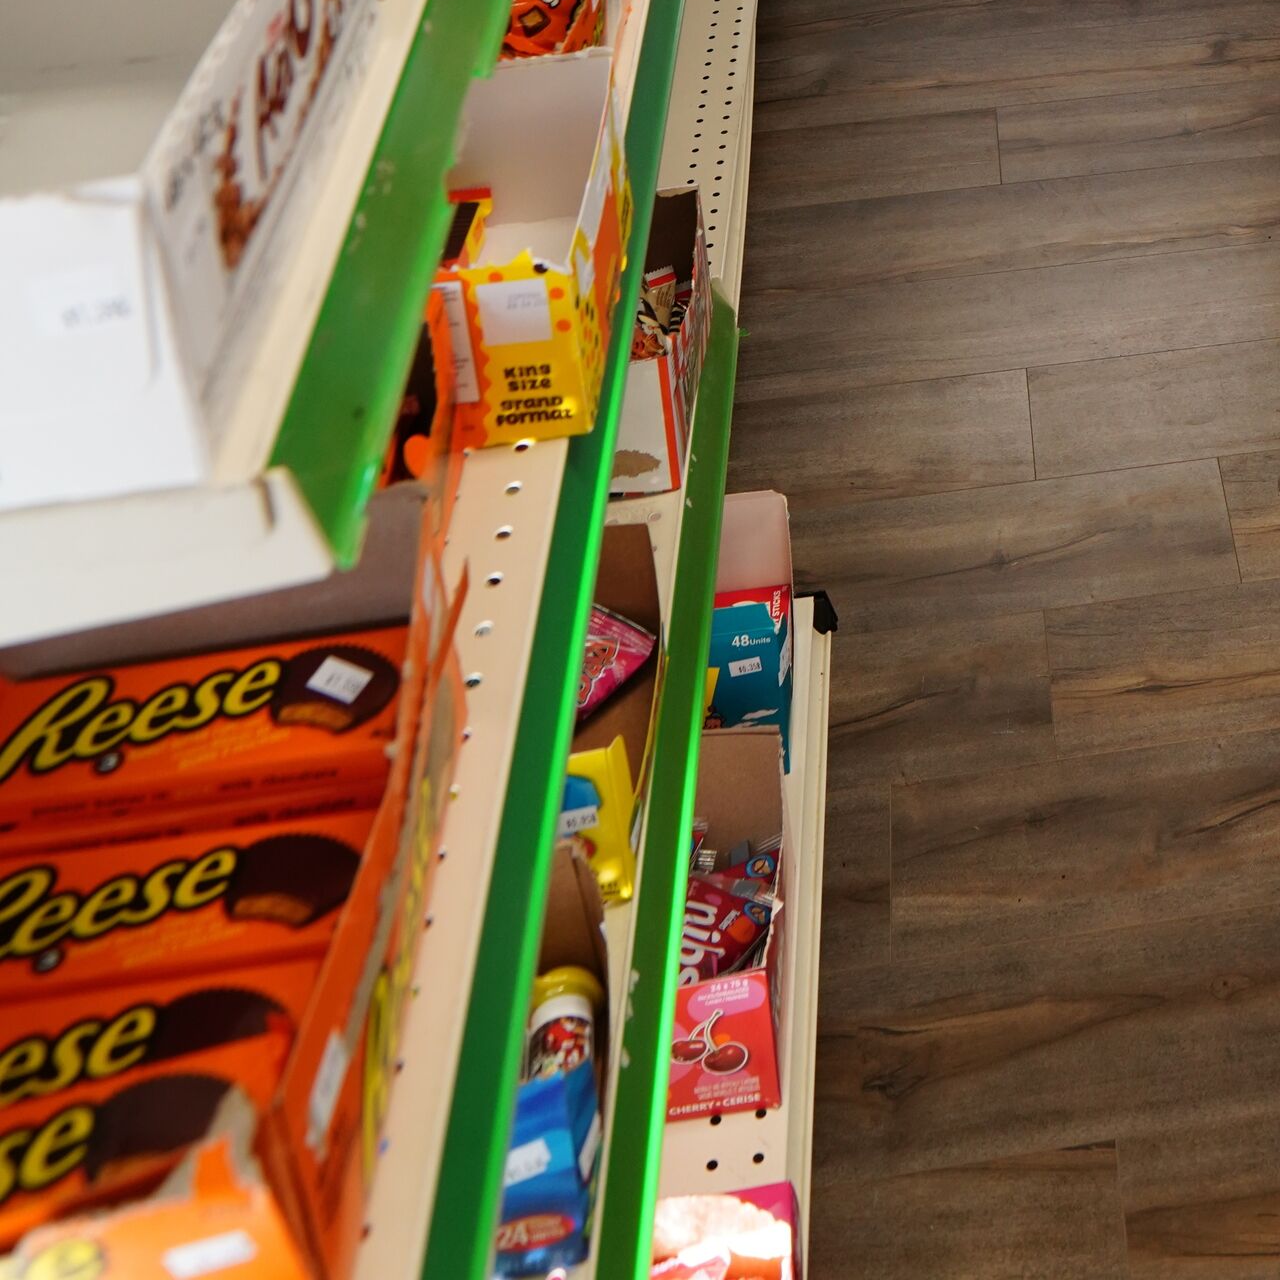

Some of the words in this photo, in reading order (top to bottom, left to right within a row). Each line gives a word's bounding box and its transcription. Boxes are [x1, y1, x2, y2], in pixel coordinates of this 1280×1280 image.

[772, 590, 781, 617] STICKS
[731, 634, 750, 648] 48
[750, 636, 772, 646] Units
[0, 657, 283, 782] Reese
[678, 899, 726, 987] nibs
[669, 1099, 715, 1116] CHERRY
[722, 1093, 762, 1107] CERISE
